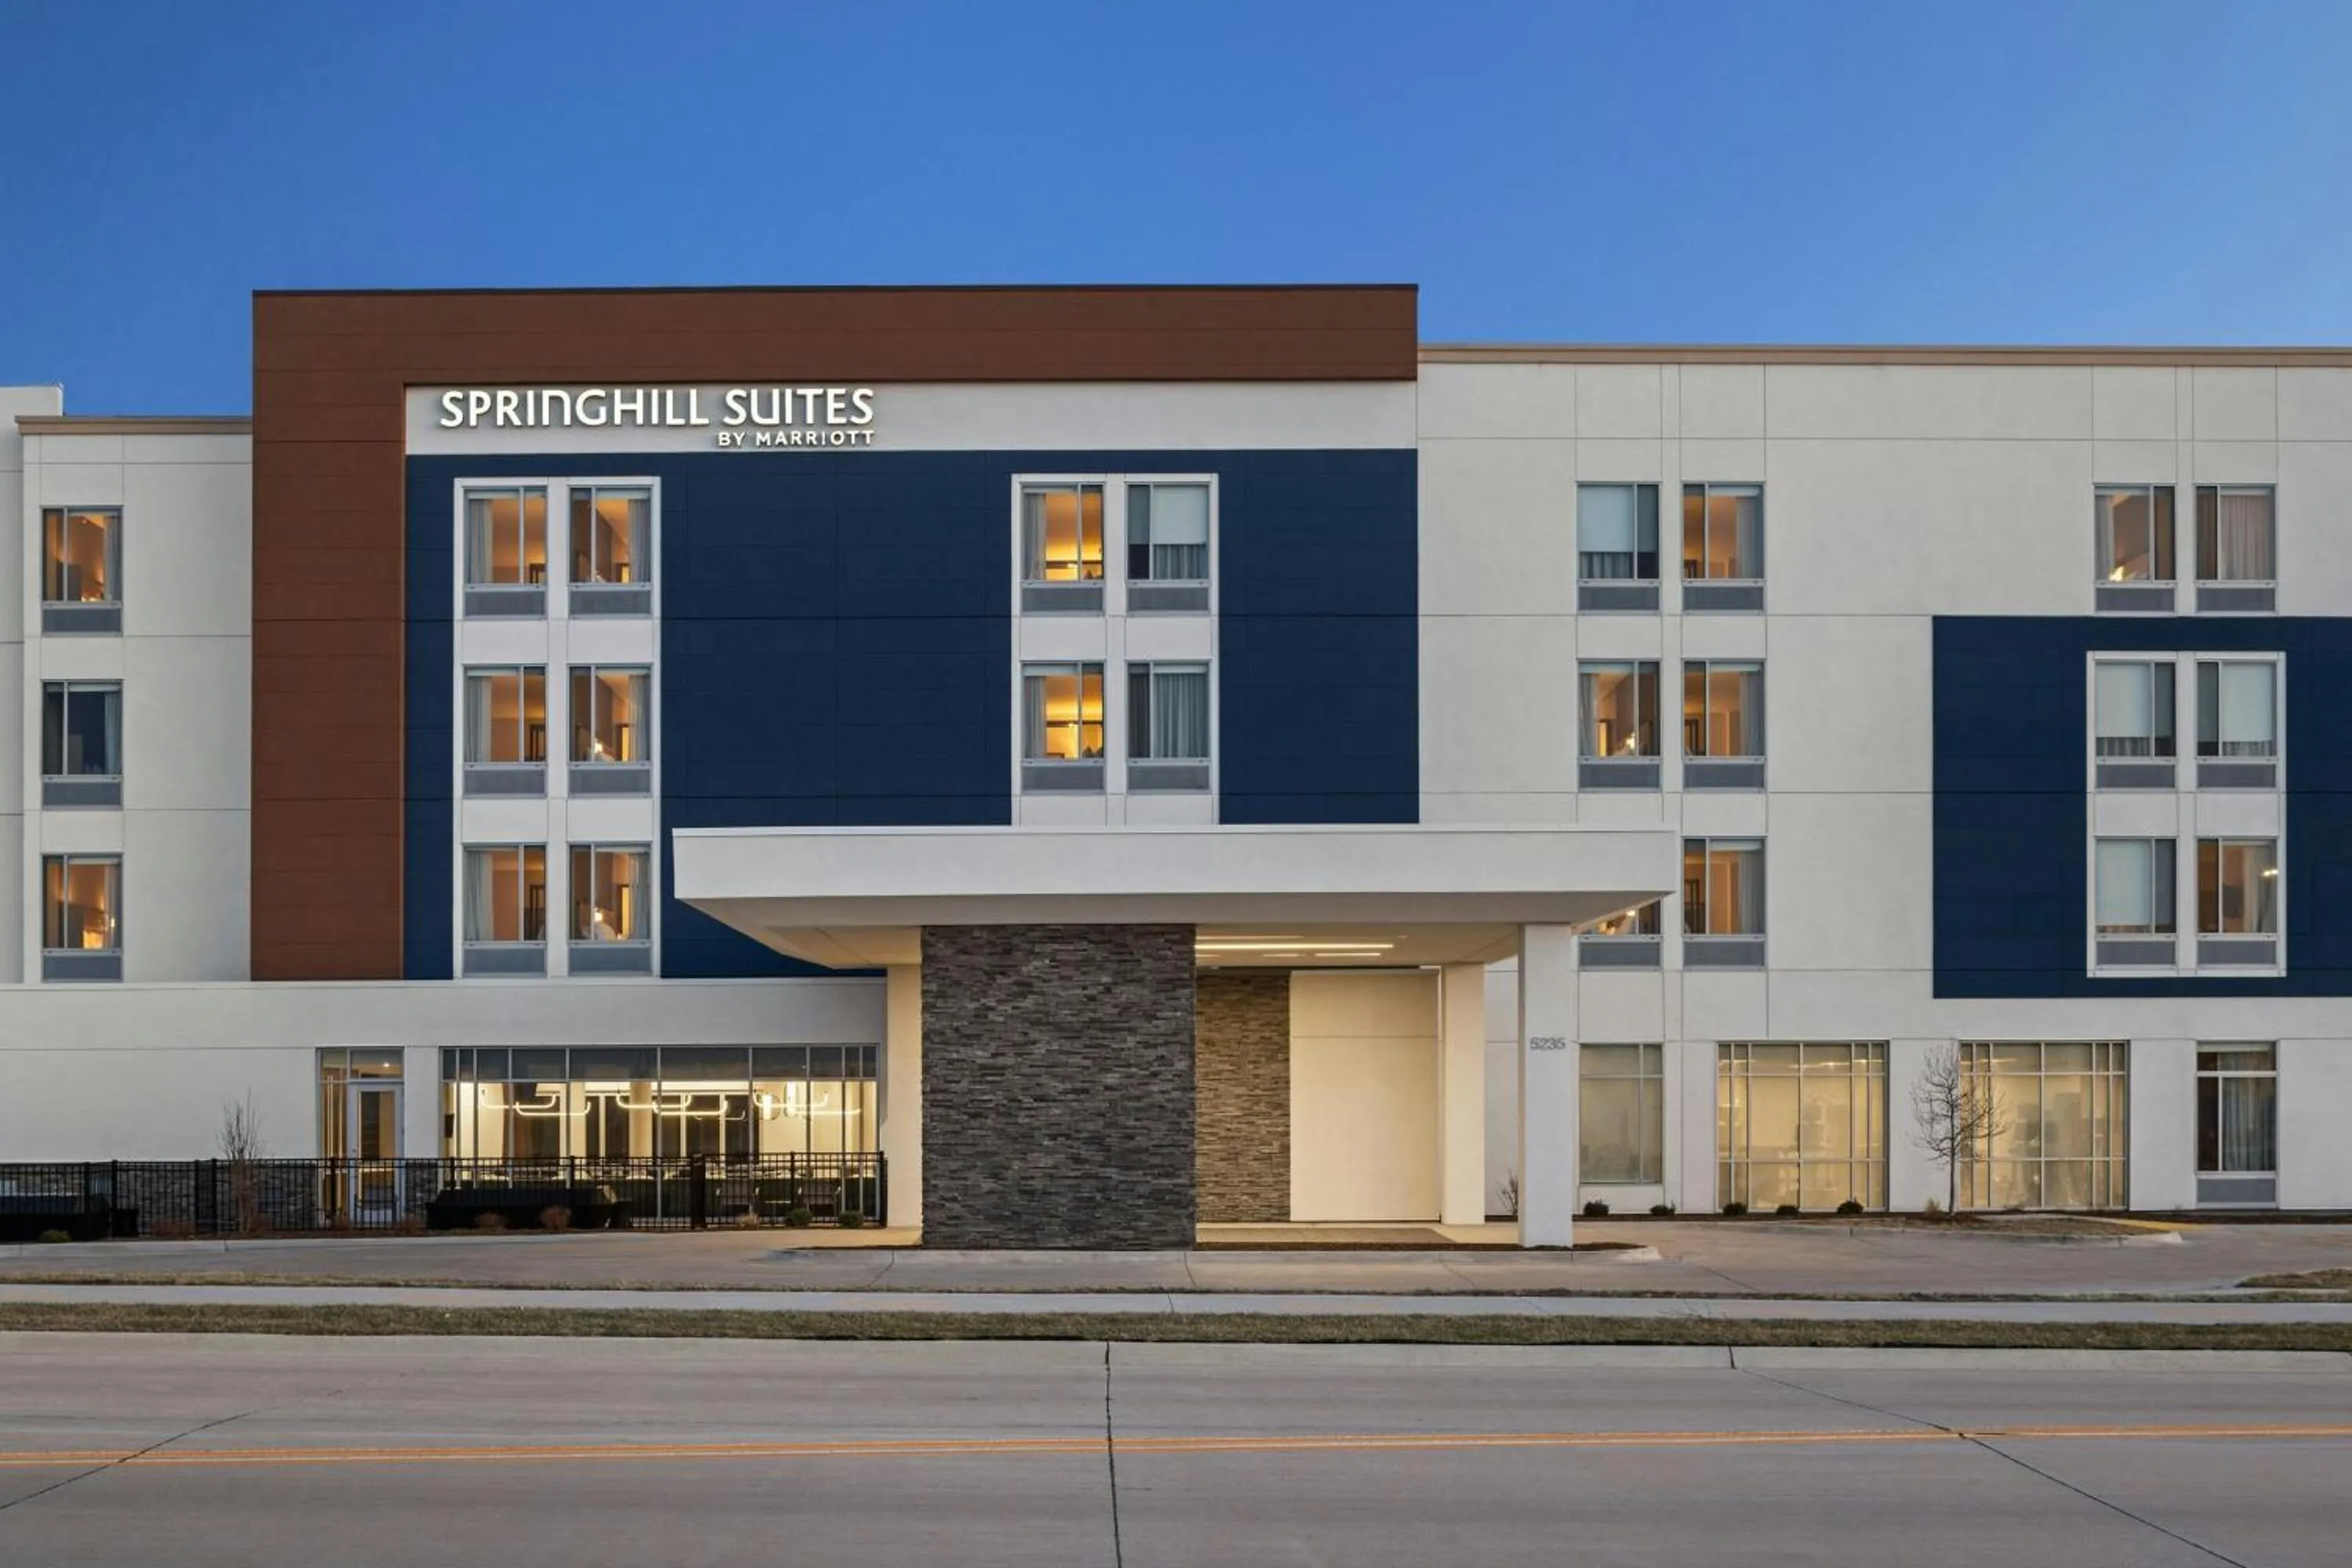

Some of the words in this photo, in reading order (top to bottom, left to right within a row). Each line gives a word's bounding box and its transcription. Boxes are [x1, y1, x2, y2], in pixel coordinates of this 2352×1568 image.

[439, 389, 710, 426] SPRINGHILL
[723, 388, 874, 425] SUITES
[718, 432, 745, 447] BY
[756, 430, 875, 446] MARRIOTT
[1530, 1036, 1566, 1051] 5235
